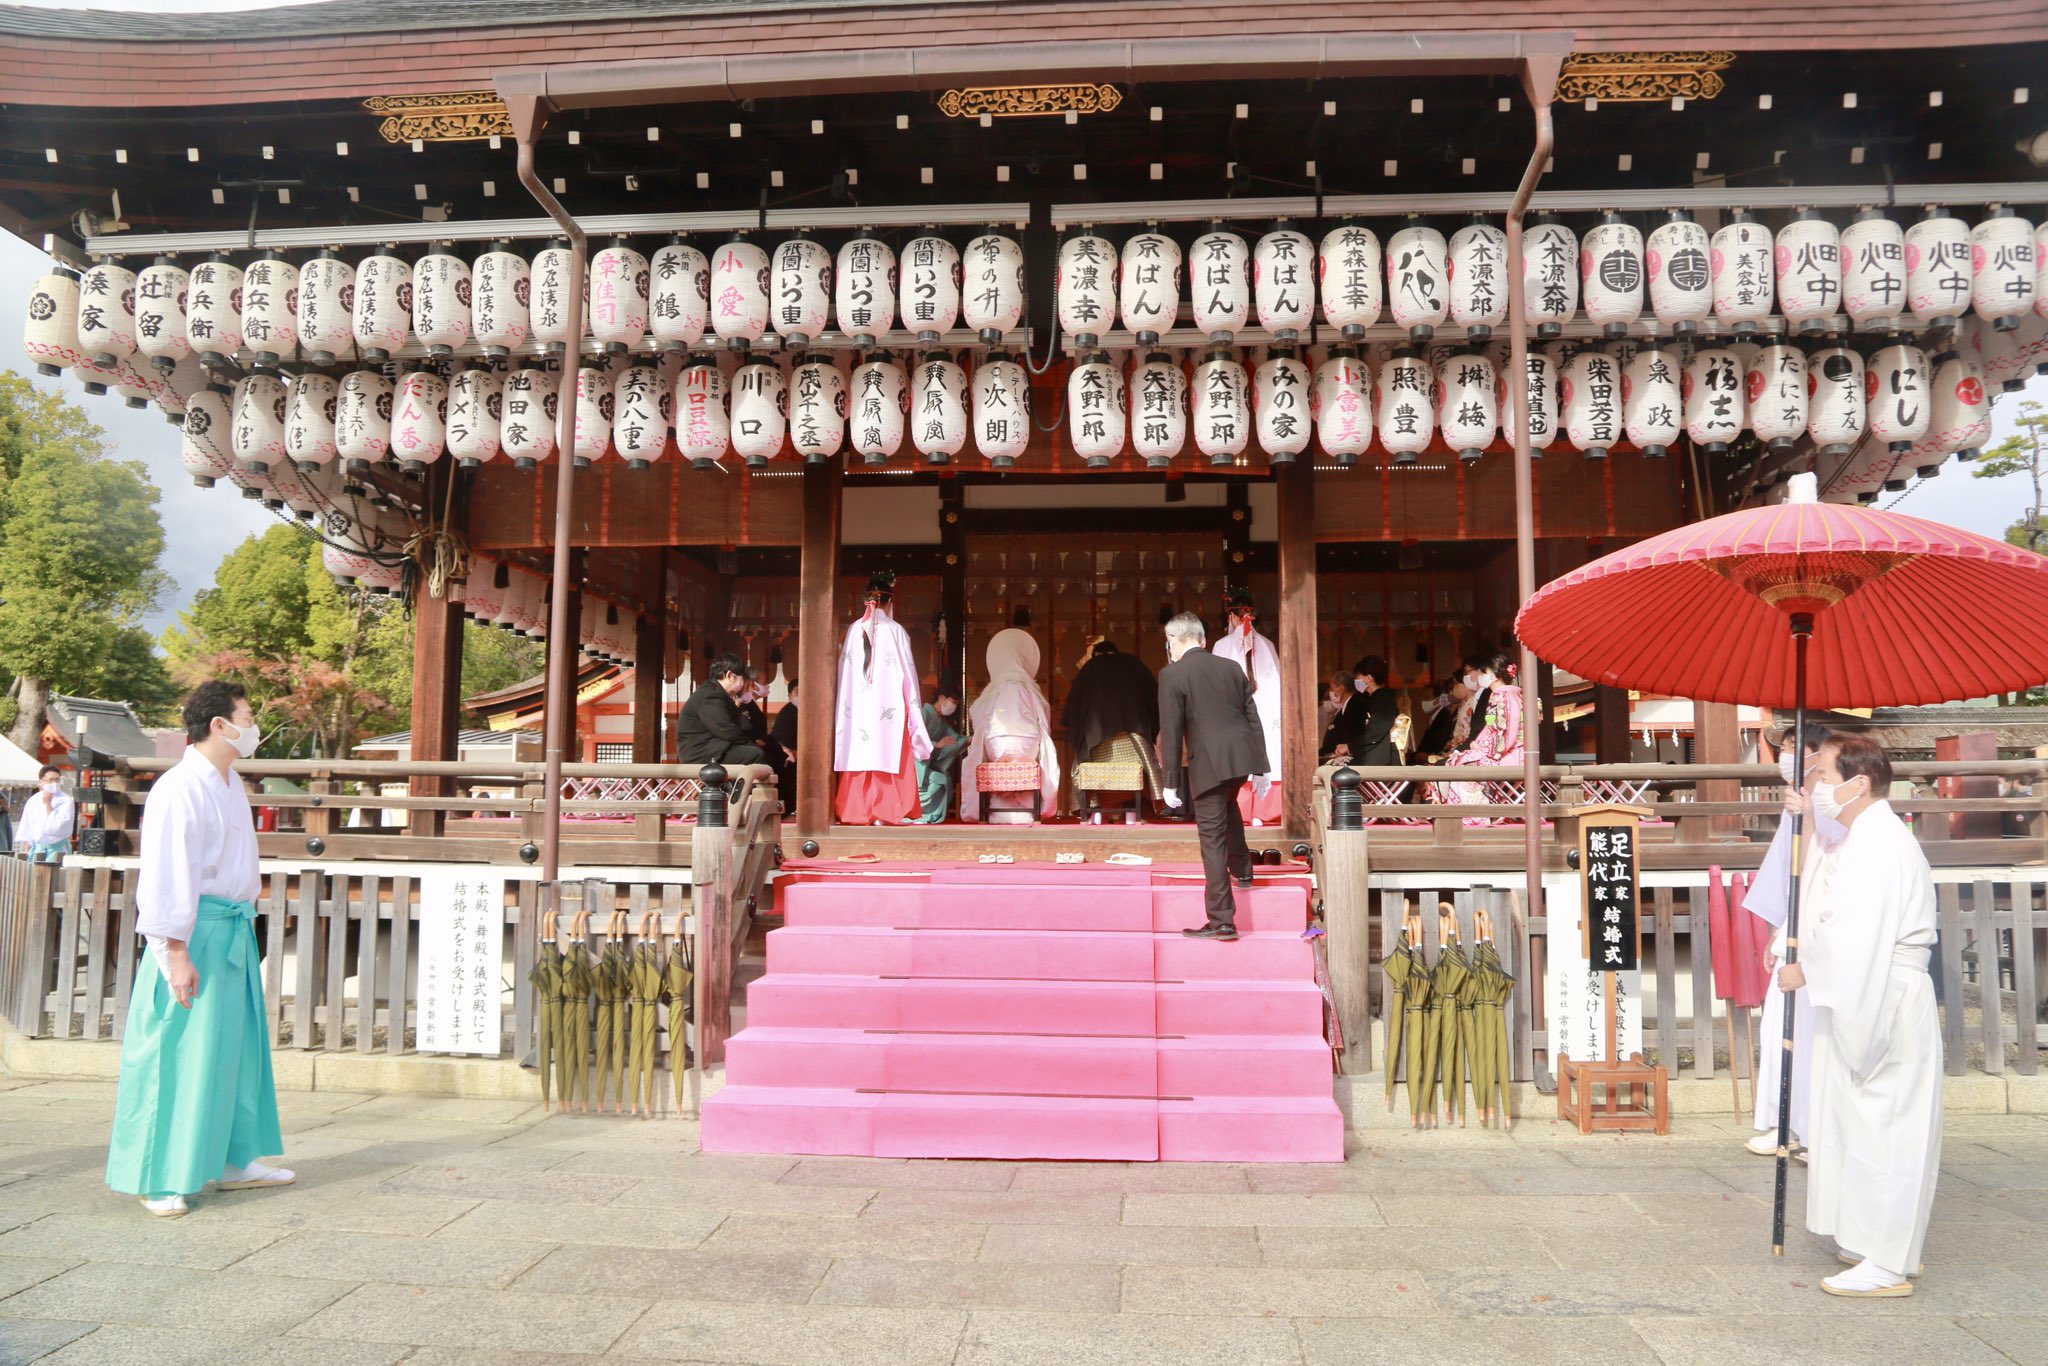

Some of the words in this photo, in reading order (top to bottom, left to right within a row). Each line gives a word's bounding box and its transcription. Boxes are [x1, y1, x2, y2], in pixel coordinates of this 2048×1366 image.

[139, 274, 164, 337] 辻留
[191, 264, 216, 339] 権兵衛
[244, 262, 272, 341] 権兵衛
[718, 250, 745, 317] 小愛
[781, 242, 804, 325] 祇園いづ重
[851, 242, 875, 327] 祇園いづ重
[914, 239, 938, 321] 祇園いづ重
[974, 239, 1001, 317] 菊乃井
[1071, 239, 1101, 323] 美濃幸
[1133, 236, 1164, 315] 京ばん
[1203, 236, 1234, 314] 京ばん
[1270, 234, 1300, 313] 京ばん
[1339, 229, 1370, 311] 祐森正幸
[1468, 229, 1496, 316] 八木源太郎
[1537, 229, 1567, 317] 八木源太郎
[1737, 254, 1755, 305] 美容室
[1755, 249, 1769, 297] アービル
[1797, 242, 1837, 306] 畑中
[1860, 242, 1901, 305] 畑中
[1929, 241, 1970, 303] 畑中
[1994, 245, 2033, 298] 畑中
[451, 375, 472, 442] キメラ
[507, 374, 531, 446] 池田家
[622, 369, 649, 450] 美の八重
[739, 372, 763, 436] 川口
[798, 368, 821, 448] 茂山千之丞
[984, 383, 1008, 443] 次朗
[1011, 367, 1022, 439] ステーキハウス
[1080, 368, 1106, 443] 矢野一郎
[1142, 368, 1169, 445] 矢野一郎
[1207, 368, 1236, 445] 矢野一郎
[1272, 365, 1300, 438] みの家
[1334, 366, 1361, 443] 小富美
[1392, 366, 1419, 435] 照豊
[1647, 358, 1676, 428] 泉政
[1779, 354, 1801, 424] たに本
[1841, 382, 1859, 431] 末友
[1891, 368, 1919, 427] にし
[1588, 832, 1611, 901] 熊代家
[1609, 833, 1633, 900] 足立家
[451, 882, 467, 1045] 結婚式をお受けします
[472, 882, 490, 1044] 本殿・舞殿・儀式殿にて
[1602, 906, 1623, 964] 結婚式
